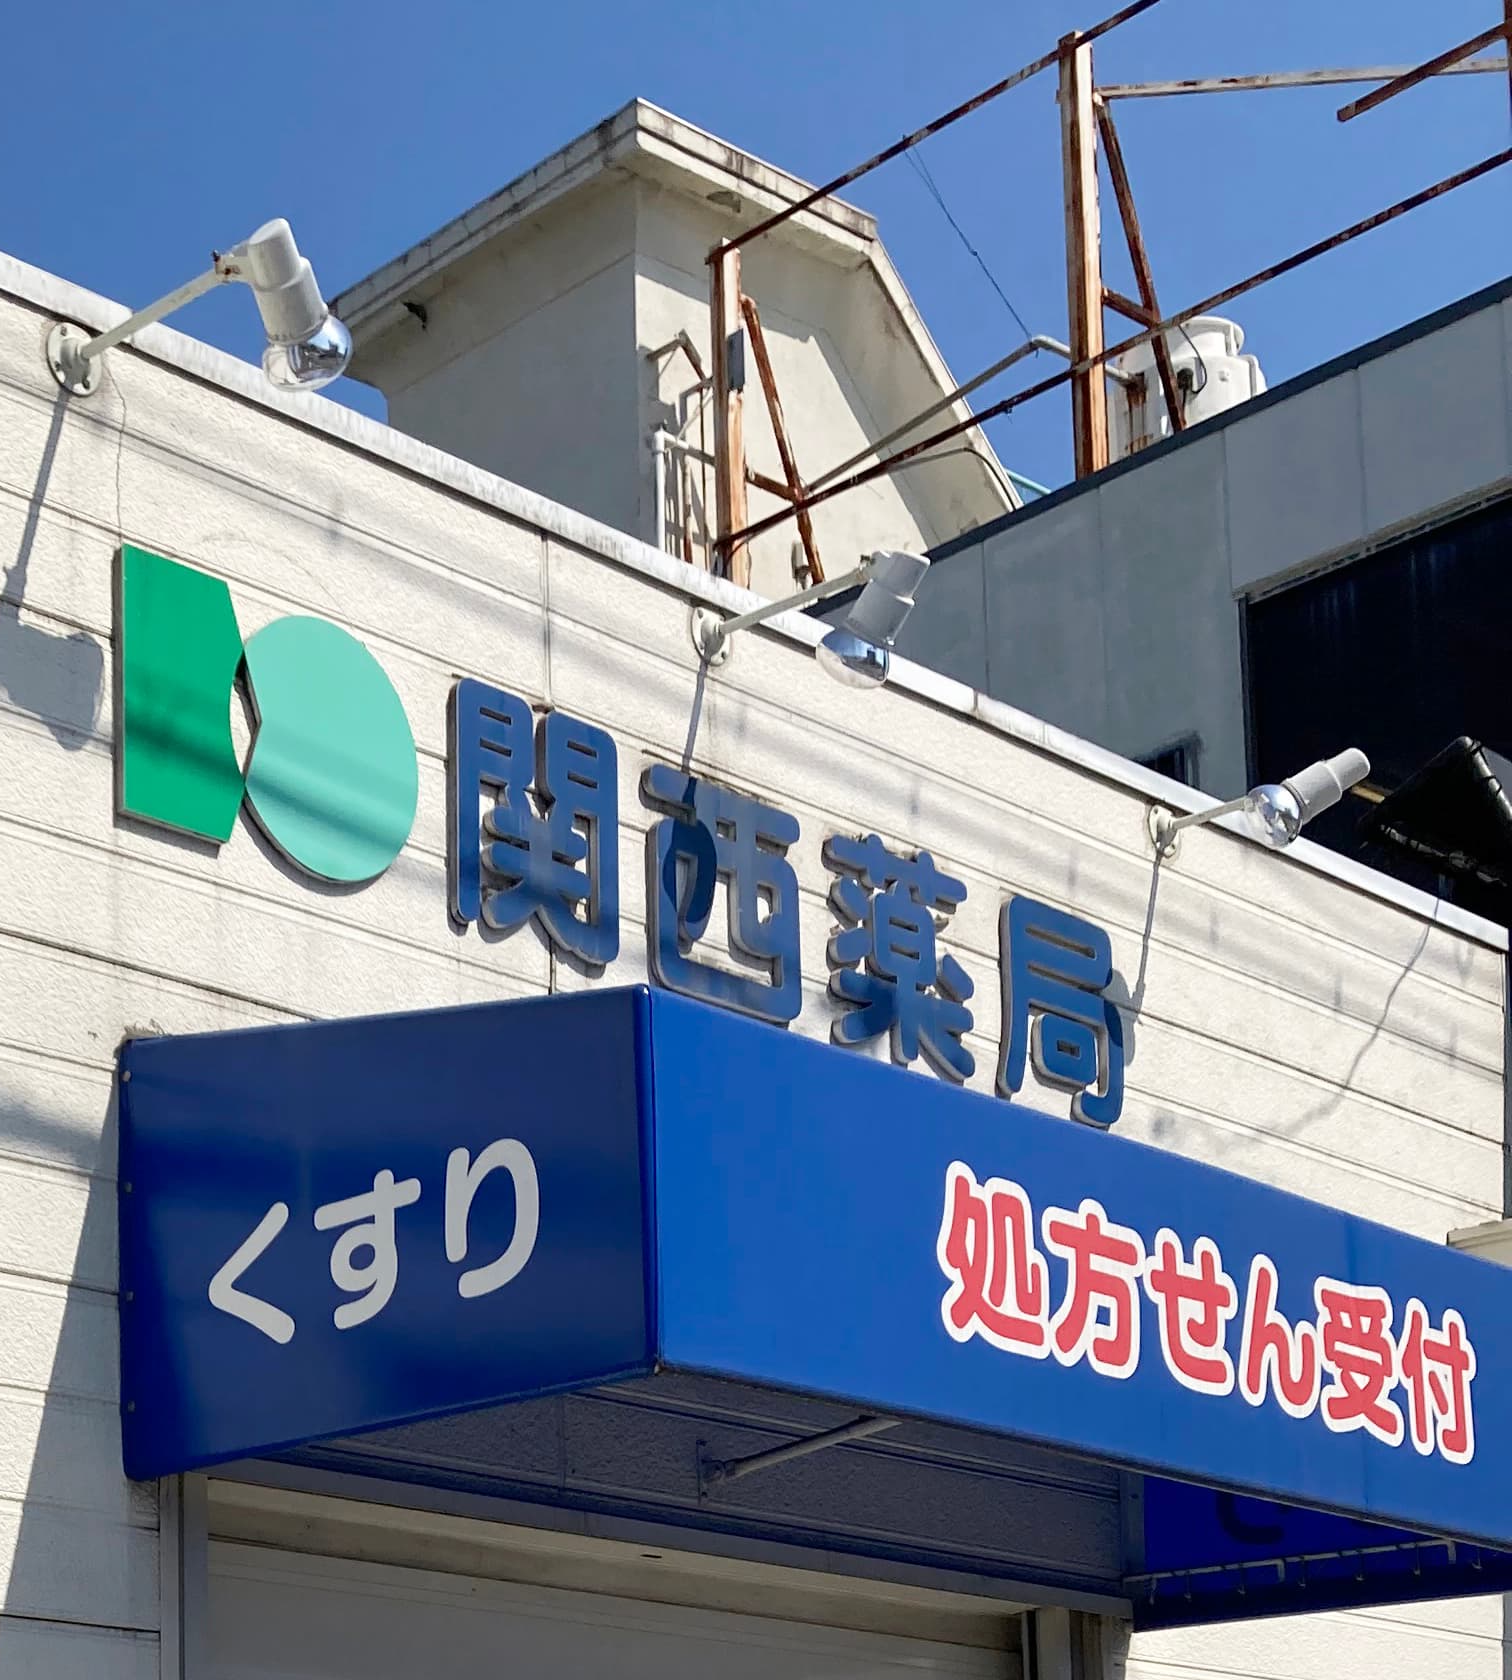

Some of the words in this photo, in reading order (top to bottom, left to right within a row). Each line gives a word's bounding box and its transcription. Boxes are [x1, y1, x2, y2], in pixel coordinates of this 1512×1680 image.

[448, 678, 1123, 1128] 関西薬局
[208, 1138, 539, 1344] くすり
[937, 1160, 1477, 1465] 処方せん受付
